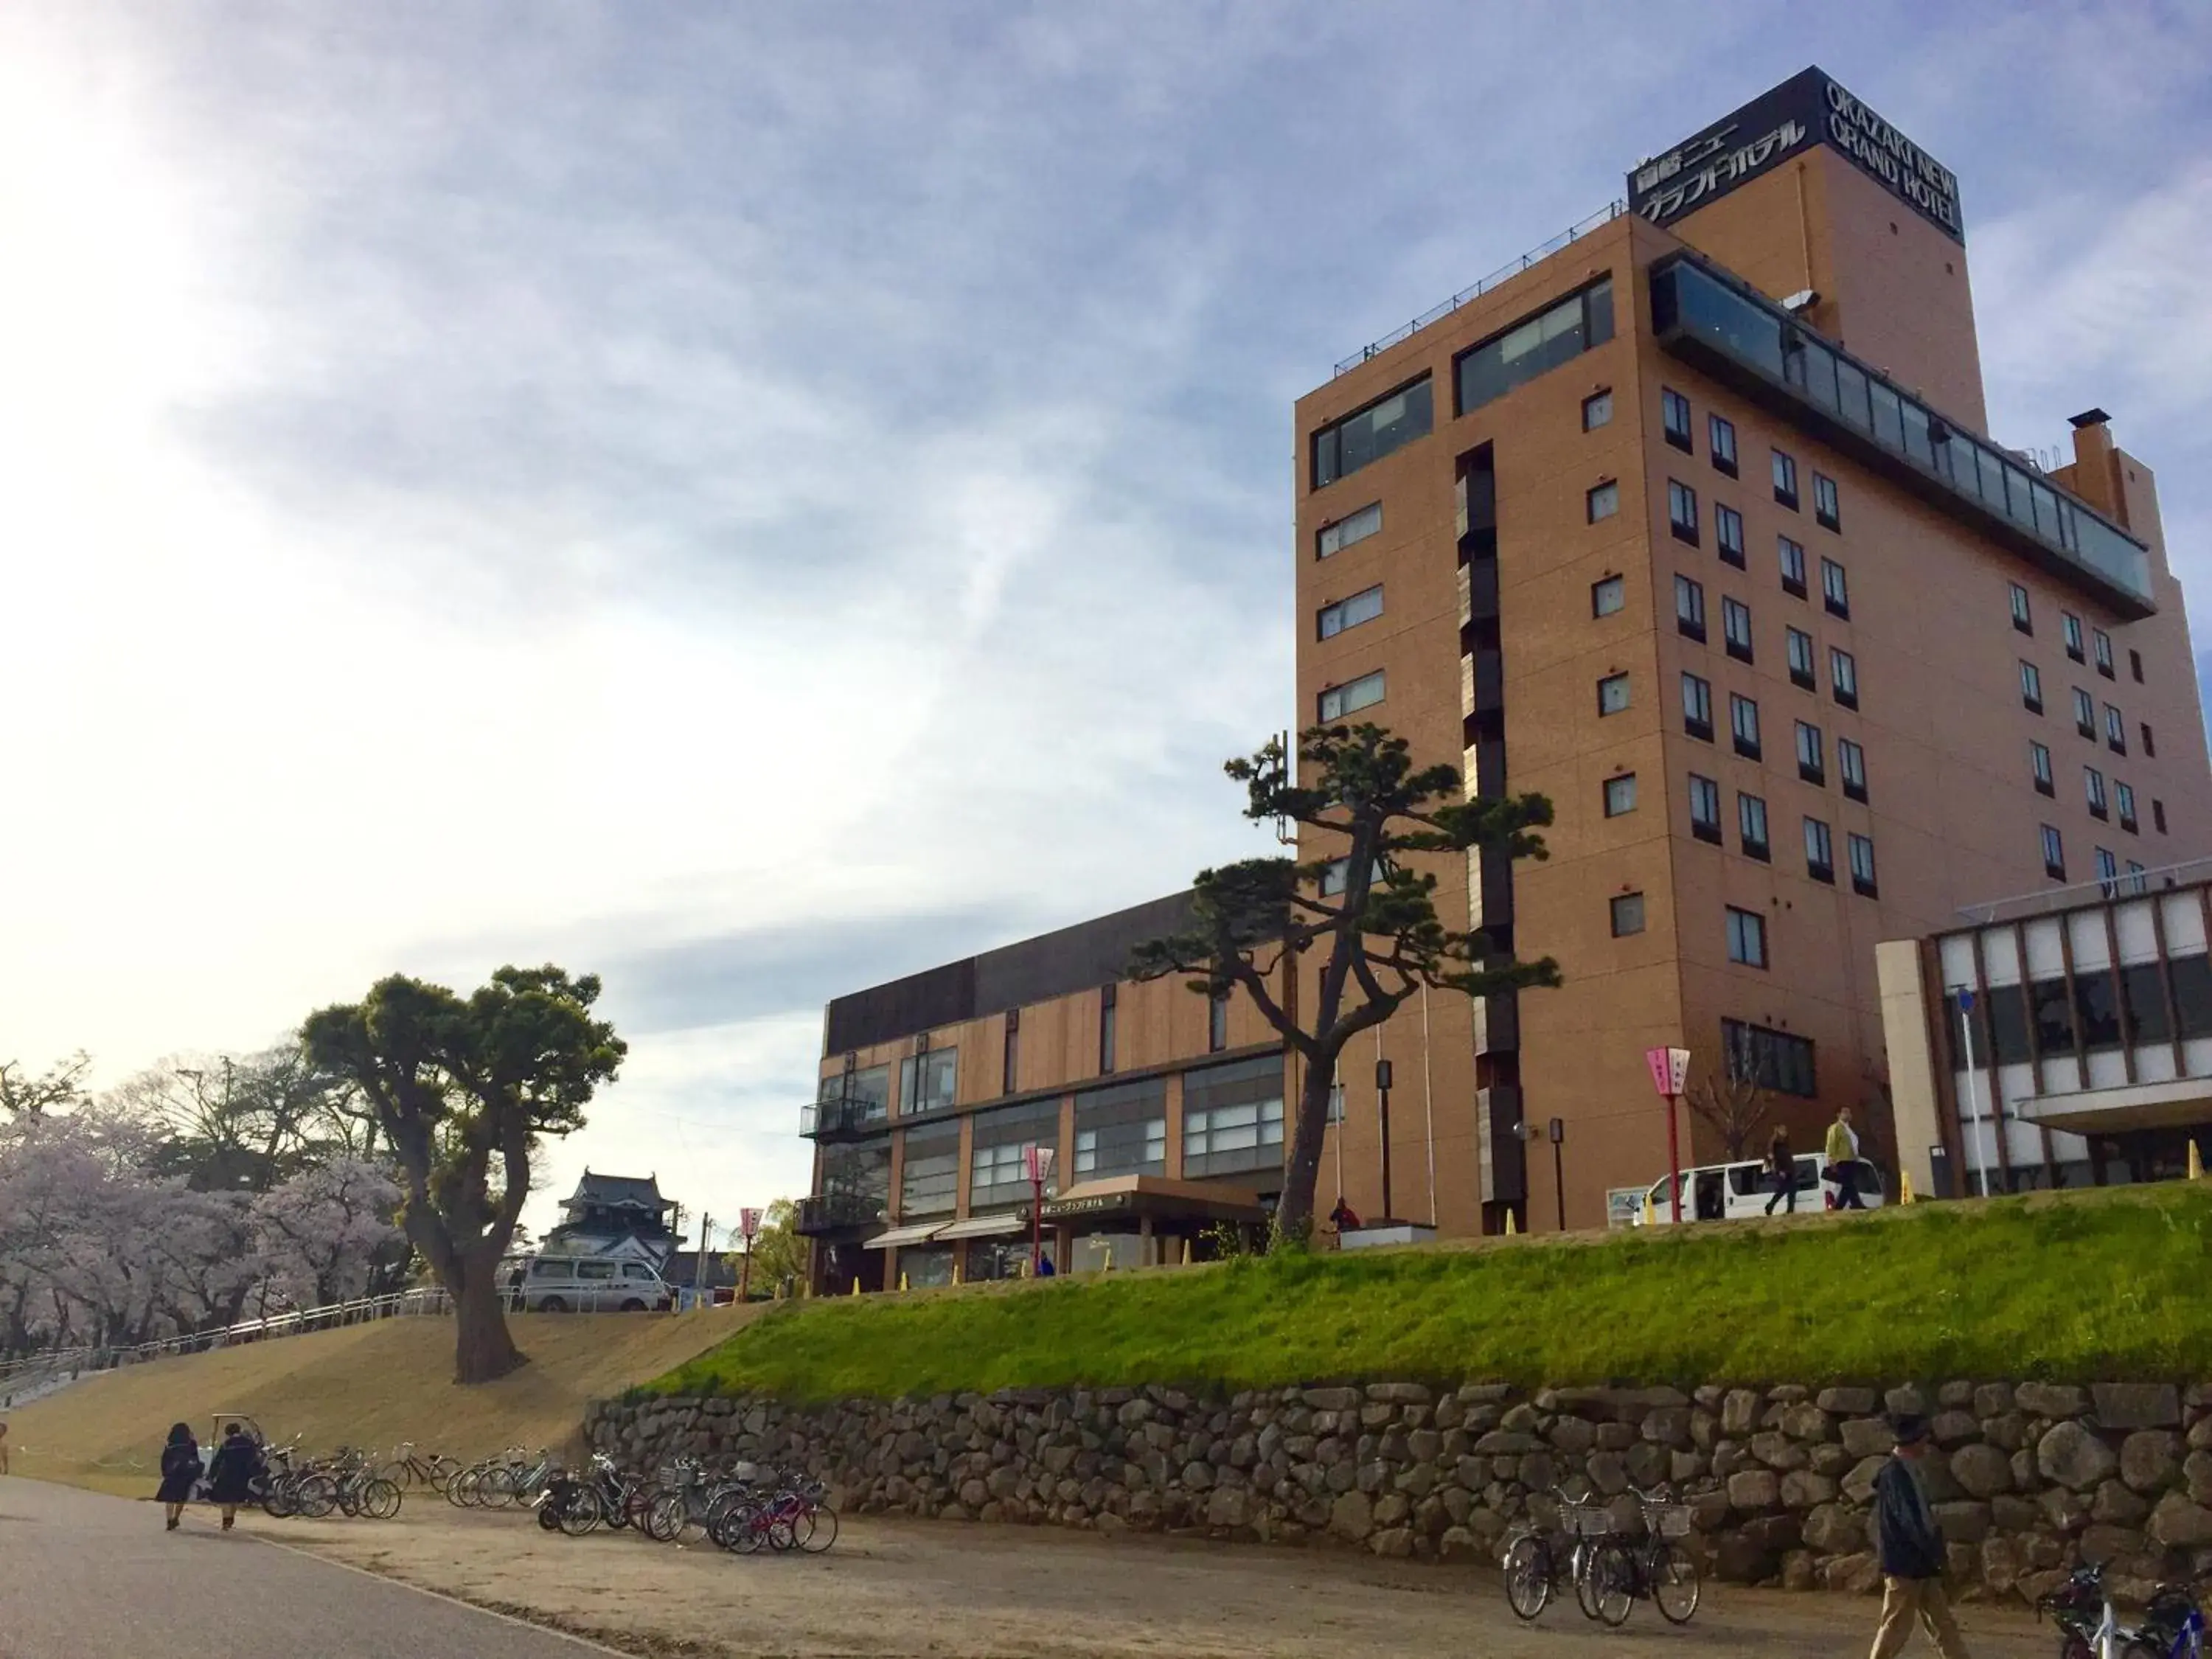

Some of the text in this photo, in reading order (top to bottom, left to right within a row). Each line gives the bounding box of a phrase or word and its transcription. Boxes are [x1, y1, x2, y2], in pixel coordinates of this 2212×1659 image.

[1640, 119, 1806, 222] グランドホテル
[1826, 81, 1954, 201] OKAZAKI NEW
[1829, 112, 1958, 230] GRAND HOTEL
